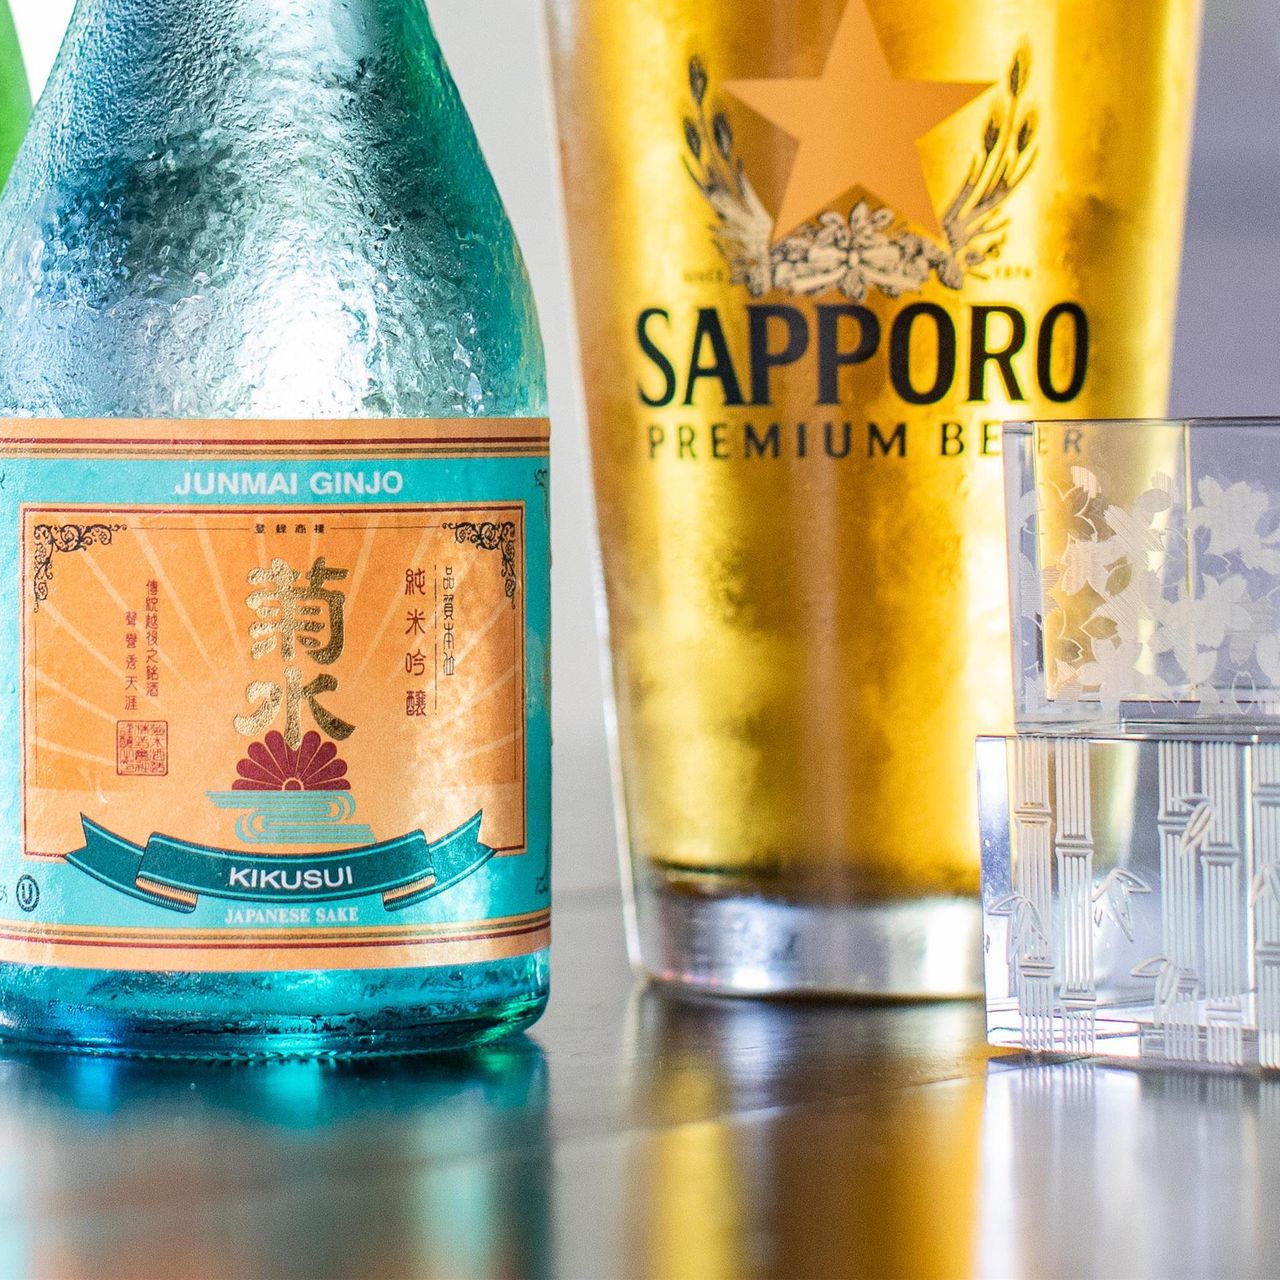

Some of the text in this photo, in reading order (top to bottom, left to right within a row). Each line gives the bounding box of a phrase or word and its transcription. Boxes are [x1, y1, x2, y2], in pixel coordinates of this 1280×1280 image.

[637, 301, 1089, 408] SAPPORO
[648, 421, 908, 459] PREMIUM
[175, 471, 404, 495] JUNMAI GINJO
[233, 557, 356, 752] 菊水
[229, 866, 353, 889] KIKUSUI
[225, 907, 359, 923] JAPANESE SAKE
